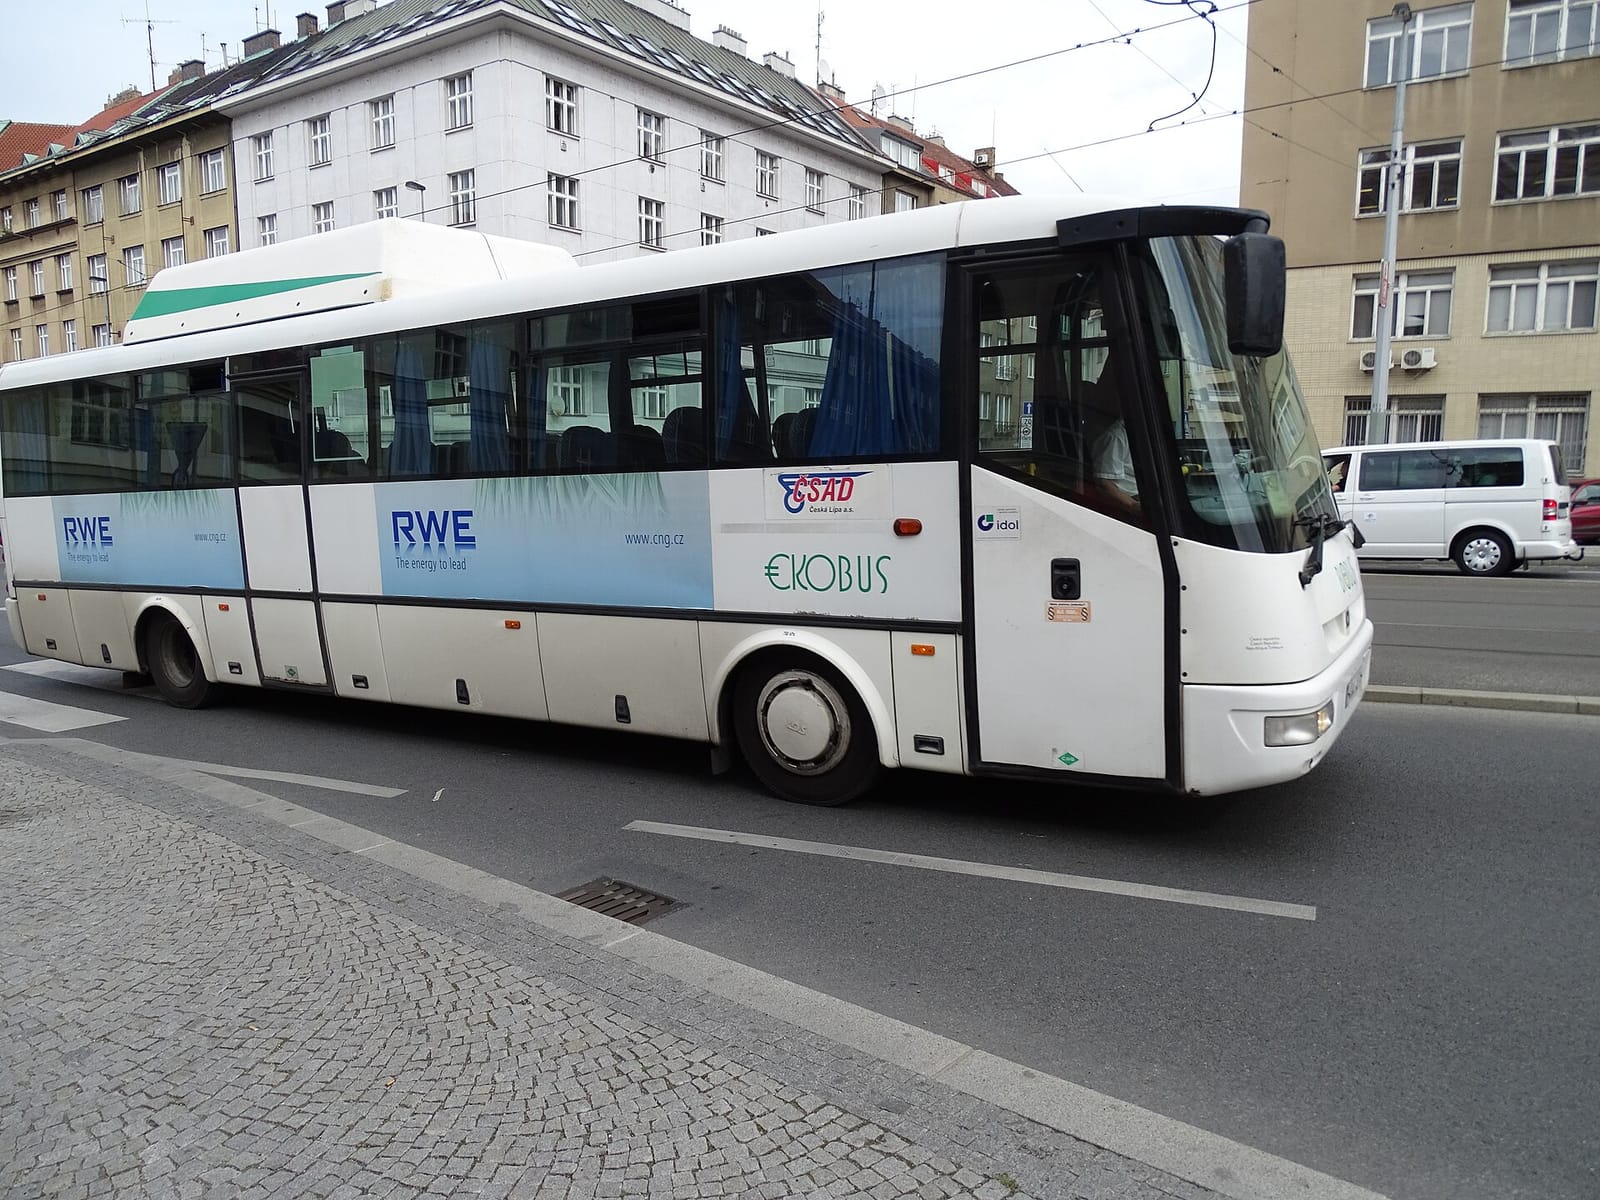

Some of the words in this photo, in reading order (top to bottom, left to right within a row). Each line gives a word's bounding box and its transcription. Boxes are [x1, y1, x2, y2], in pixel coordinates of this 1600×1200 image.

[63, 516, 113, 542] RWE
[391, 510, 477, 543] RWE
[996, 520, 1019, 530] idol
[194, 531, 226, 544] www.cng.cz
[625, 531, 684, 548] www.cng.cz
[395, 556, 409, 569] The
[411, 559, 437, 573] energy
[439, 558, 447, 570] to
[449, 557, 467, 570] lead
